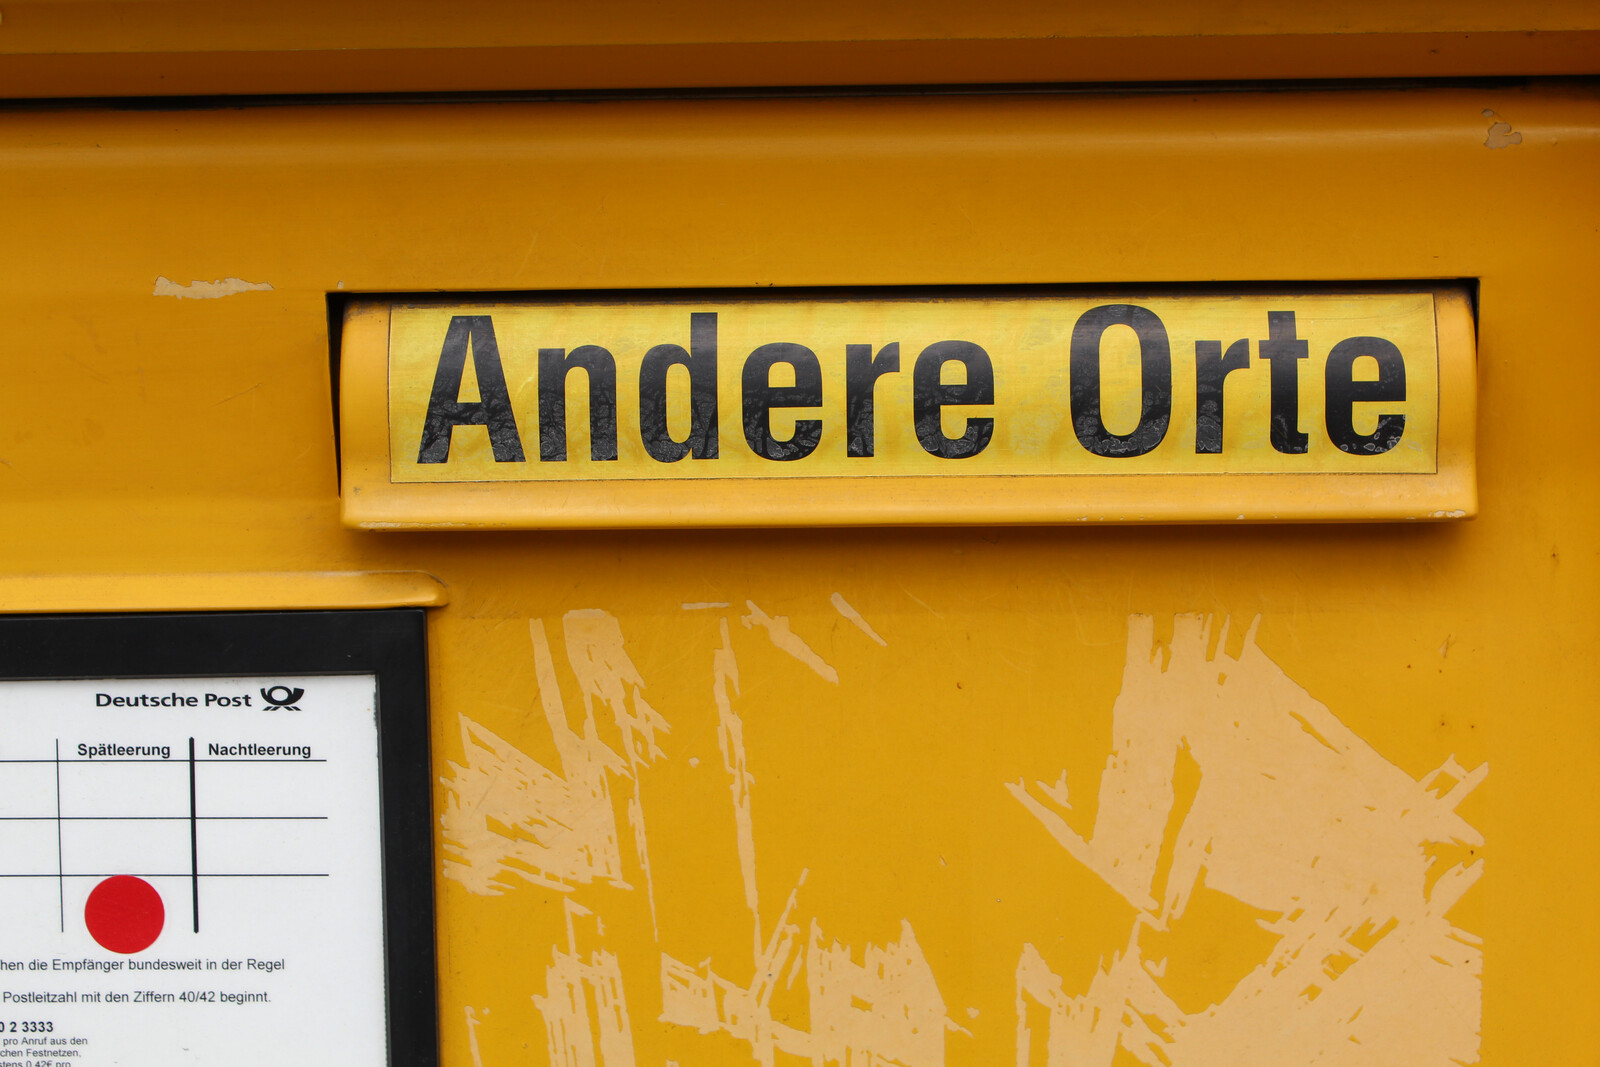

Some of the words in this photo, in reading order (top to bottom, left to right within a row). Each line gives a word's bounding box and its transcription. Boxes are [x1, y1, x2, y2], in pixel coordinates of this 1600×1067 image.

[416, 311, 995, 463] Andere
[1069, 304, 1407, 458] Orte
[95, 692, 199, 708] Deutsche
[204, 692, 253, 708] Post
[77, 743, 171, 759] Spätleerung
[208, 743, 311, 759] Nachtleerung
[0, 959, 25, 971] hen
[28, 959, 48, 971] die
[52, 958, 125, 974] Empfänger
[128, 958, 202, 971] bundesweit
[206, 958, 217, 971] in
[221, 958, 243, 971] der
[246, 958, 286, 974] Regel
[2, 991, 77, 1004] Postleitzahl
[81, 991, 101, 1003] mit
[104, 991, 129, 1003] den
[133, 990, 175, 1003] Ziffern
[178, 990, 216, 1003] 40/42
[220, 990, 271, 1006] beginnt.
[10, 1021, 17, 1033] 2
[21, 1021, 54, 1033] 3333
[3, 1038, 19, 1047] pro
[21, 1036, 48, 1046] Anruf
[50, 1038, 67, 1046] aus
[70, 1036, 88, 1046] den
